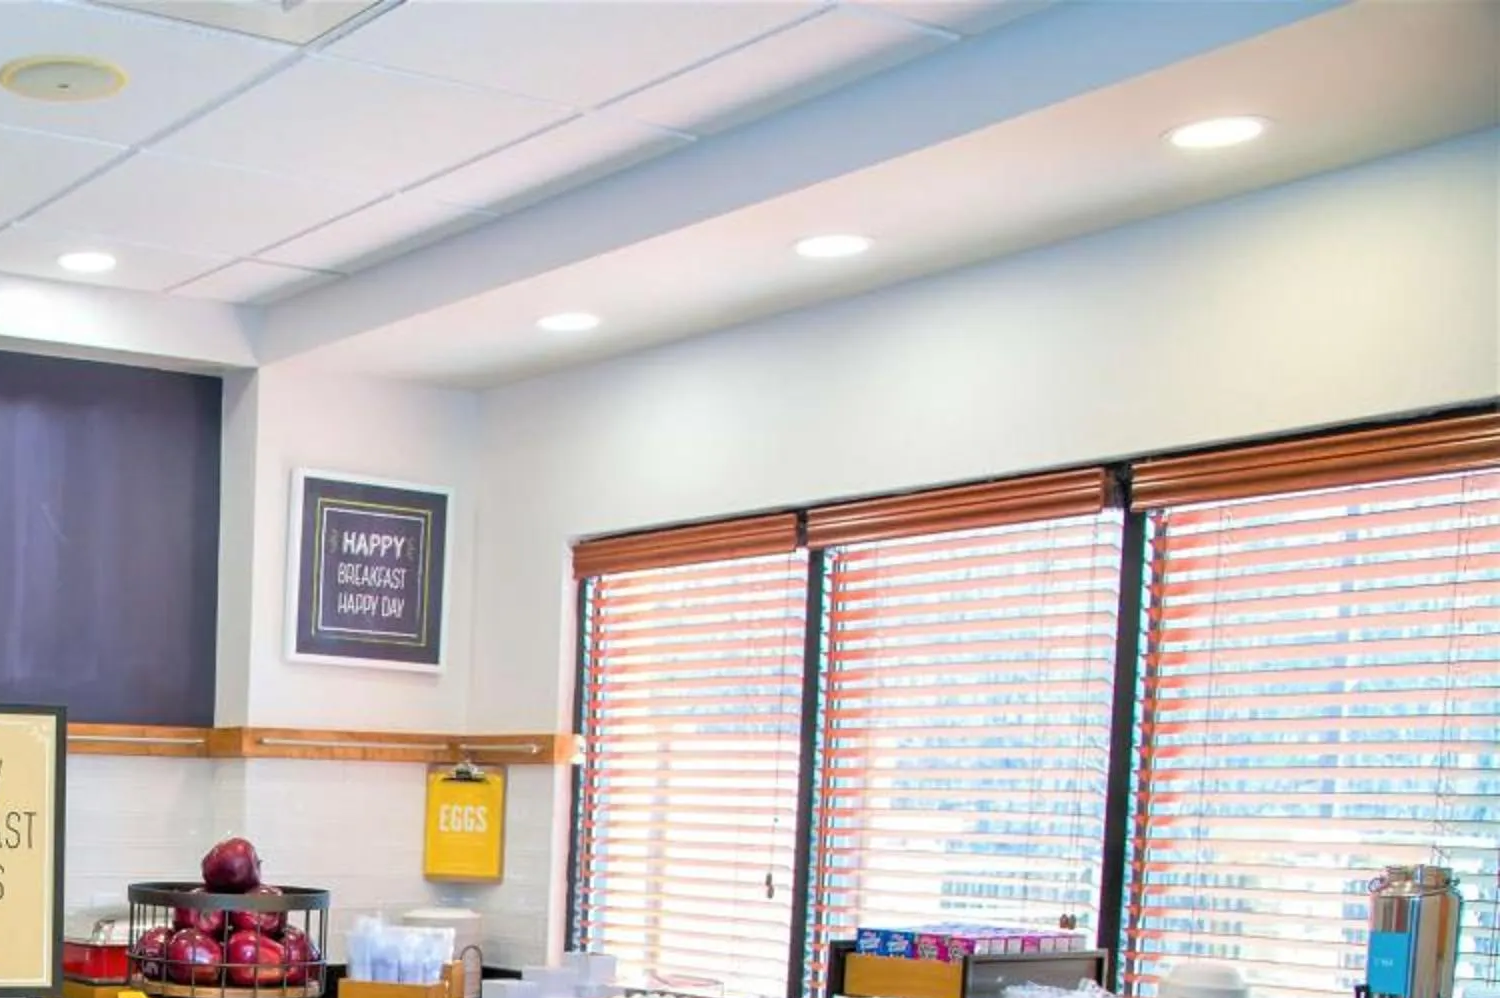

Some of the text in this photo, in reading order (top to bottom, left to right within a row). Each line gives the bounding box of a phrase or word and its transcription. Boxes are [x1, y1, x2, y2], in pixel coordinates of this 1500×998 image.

[342, 530, 405, 560] HAPPY
[337, 562, 407, 590] BREAKFAST
[337, 592, 405, 618] HAPPY DAY
[438, 803, 488, 833] EGGS
